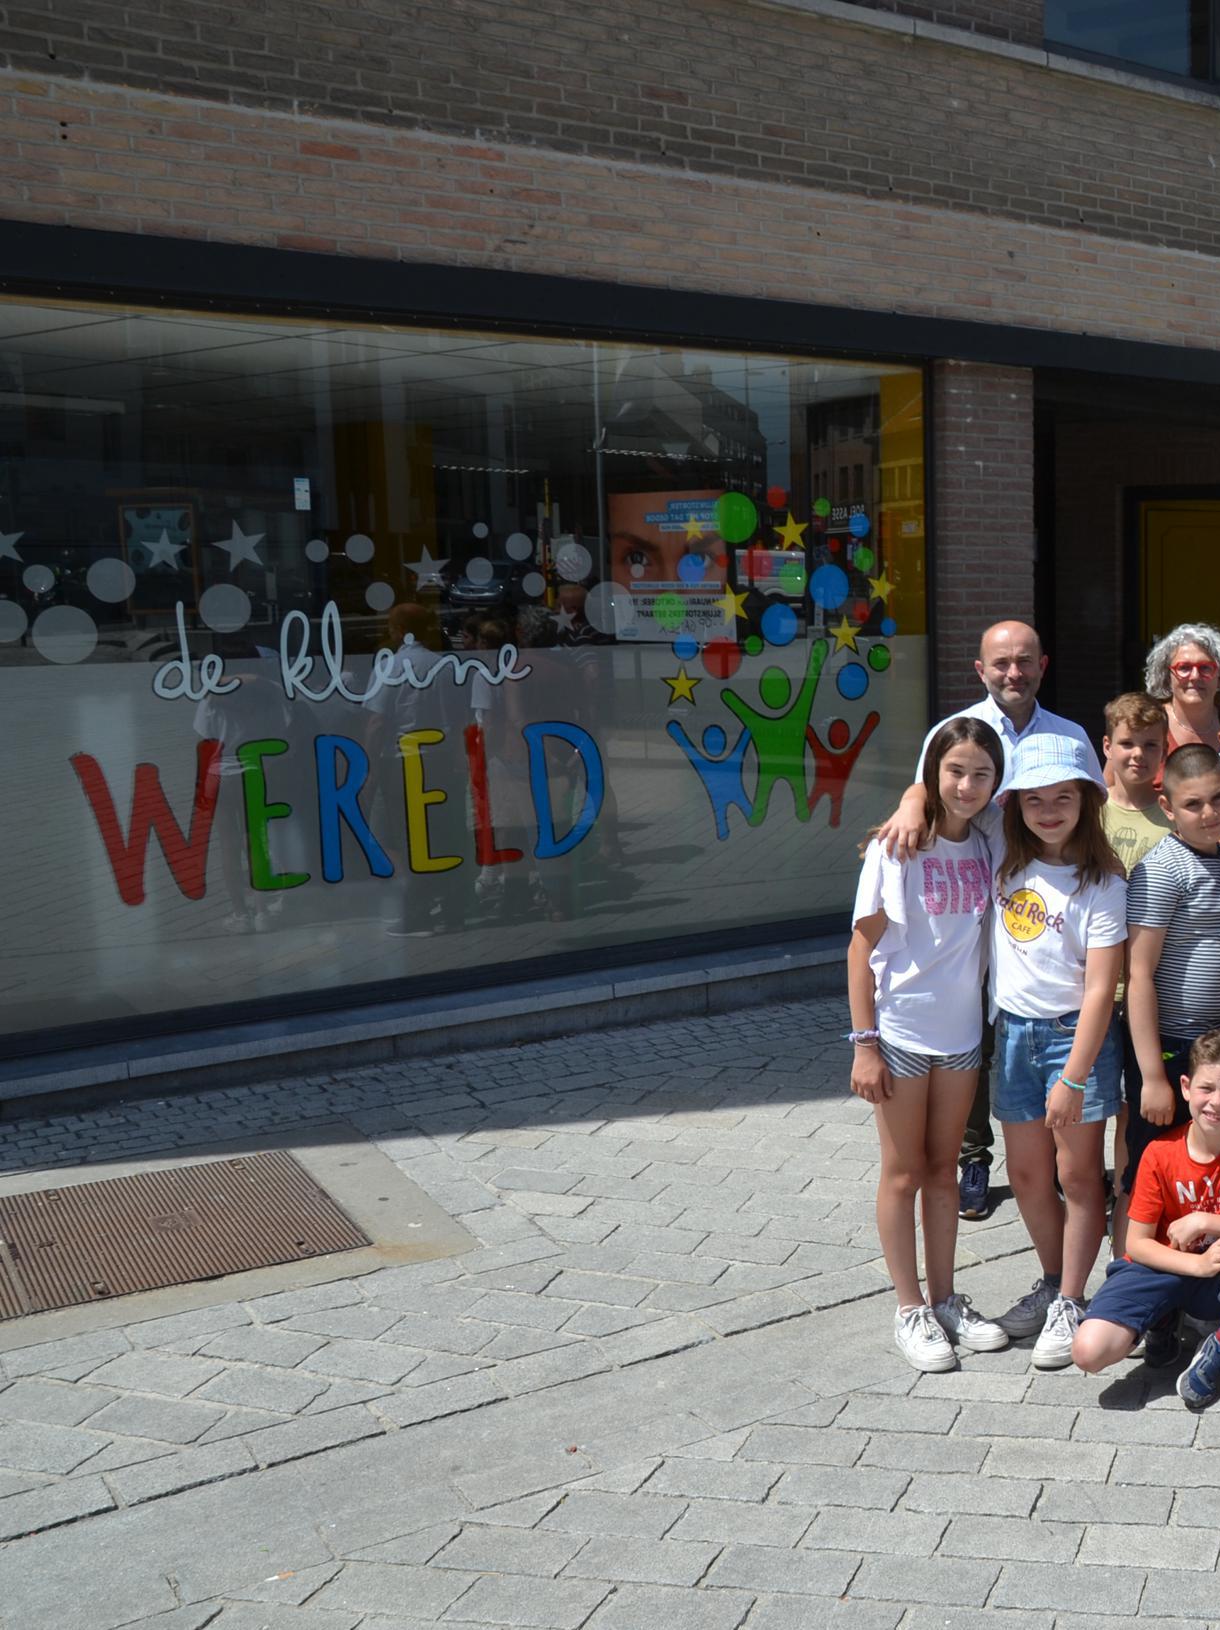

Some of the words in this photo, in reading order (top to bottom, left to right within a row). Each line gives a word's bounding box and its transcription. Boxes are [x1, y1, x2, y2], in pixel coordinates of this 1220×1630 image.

[152, 600, 242, 701] de
[280, 601, 533, 704] kleine
[69, 720, 605, 907] WERELD
[1026, 903, 1065, 935] Rock
